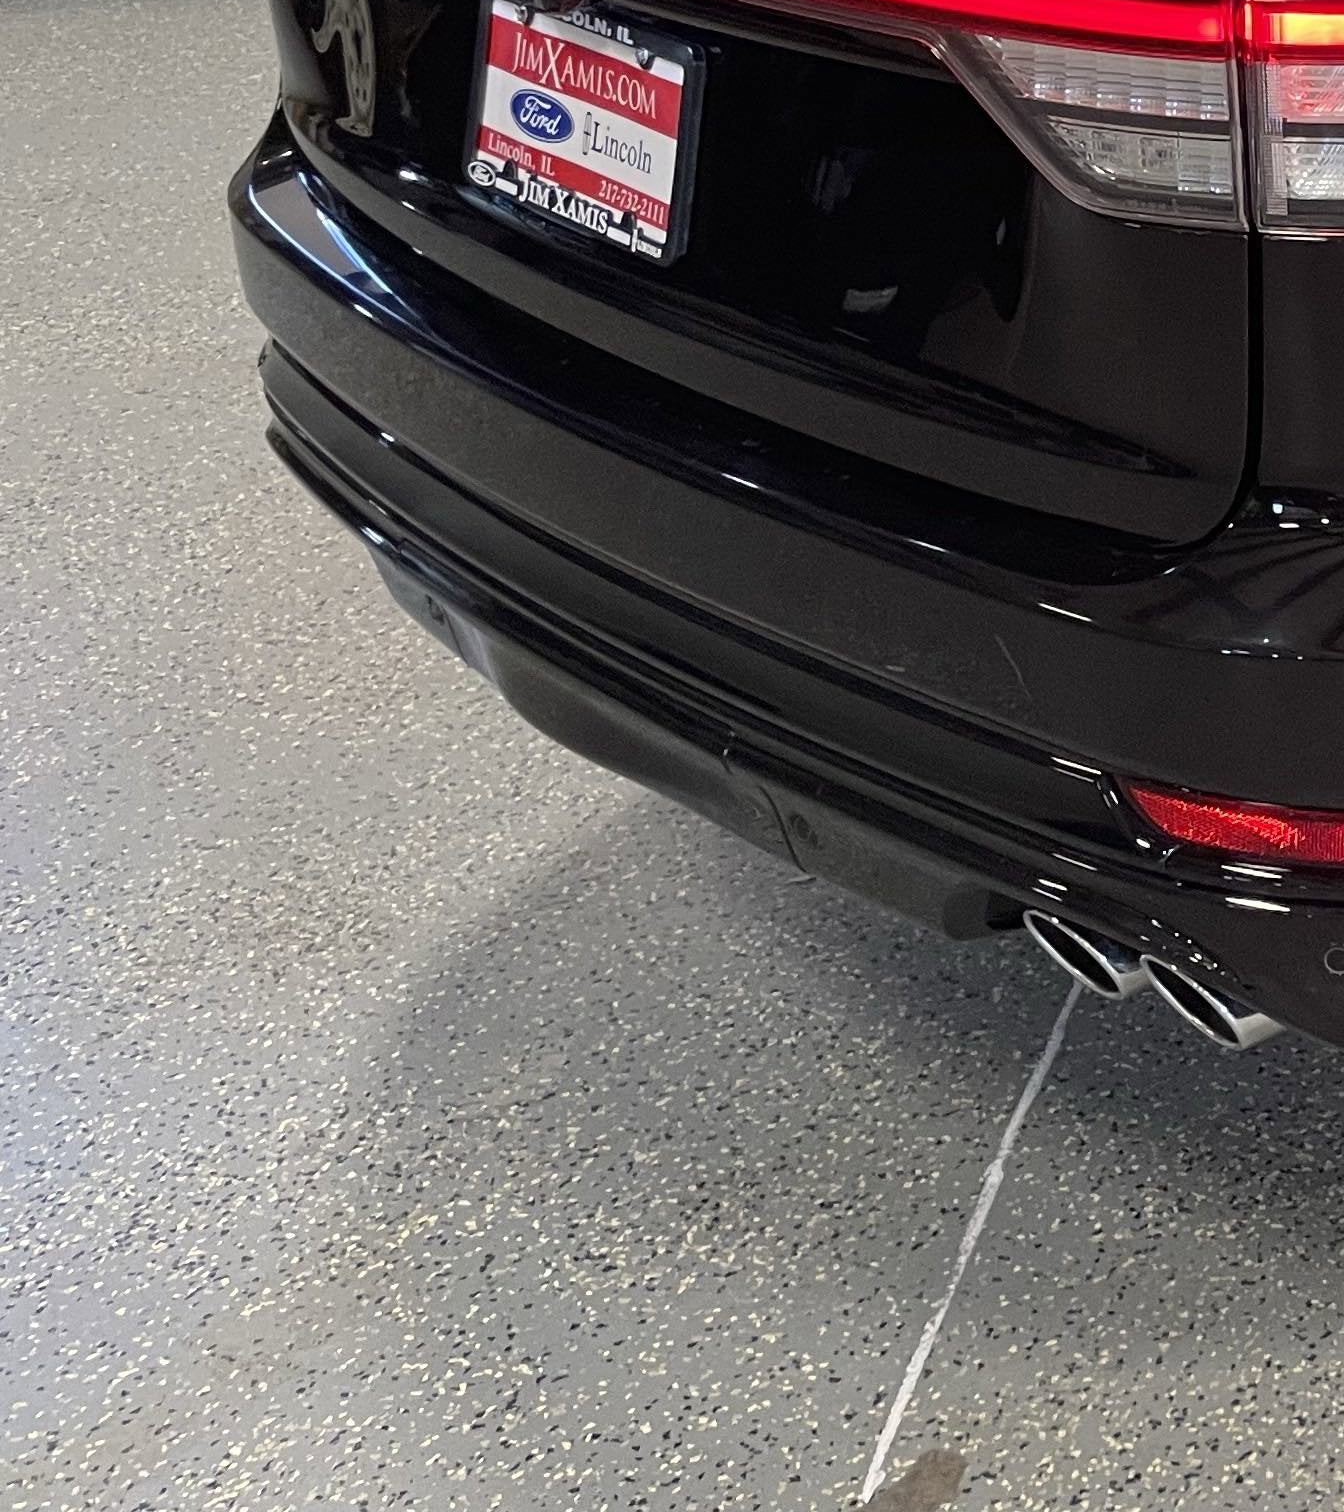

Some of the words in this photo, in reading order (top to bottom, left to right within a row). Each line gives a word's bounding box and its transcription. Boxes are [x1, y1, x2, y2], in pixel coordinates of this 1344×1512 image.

[616, 25, 634, 46] IL
[512, 31, 657, 120] JIMXAMIS.COM
[520, 95, 561, 136] Ford
[541, 158, 556, 177] IL
[591, 121, 652, 175] Lincoln
[519, 174, 550, 209] JIM
[552, 183, 609, 234] XAMIS
[599, 179, 666, 226] 217-732-2111
